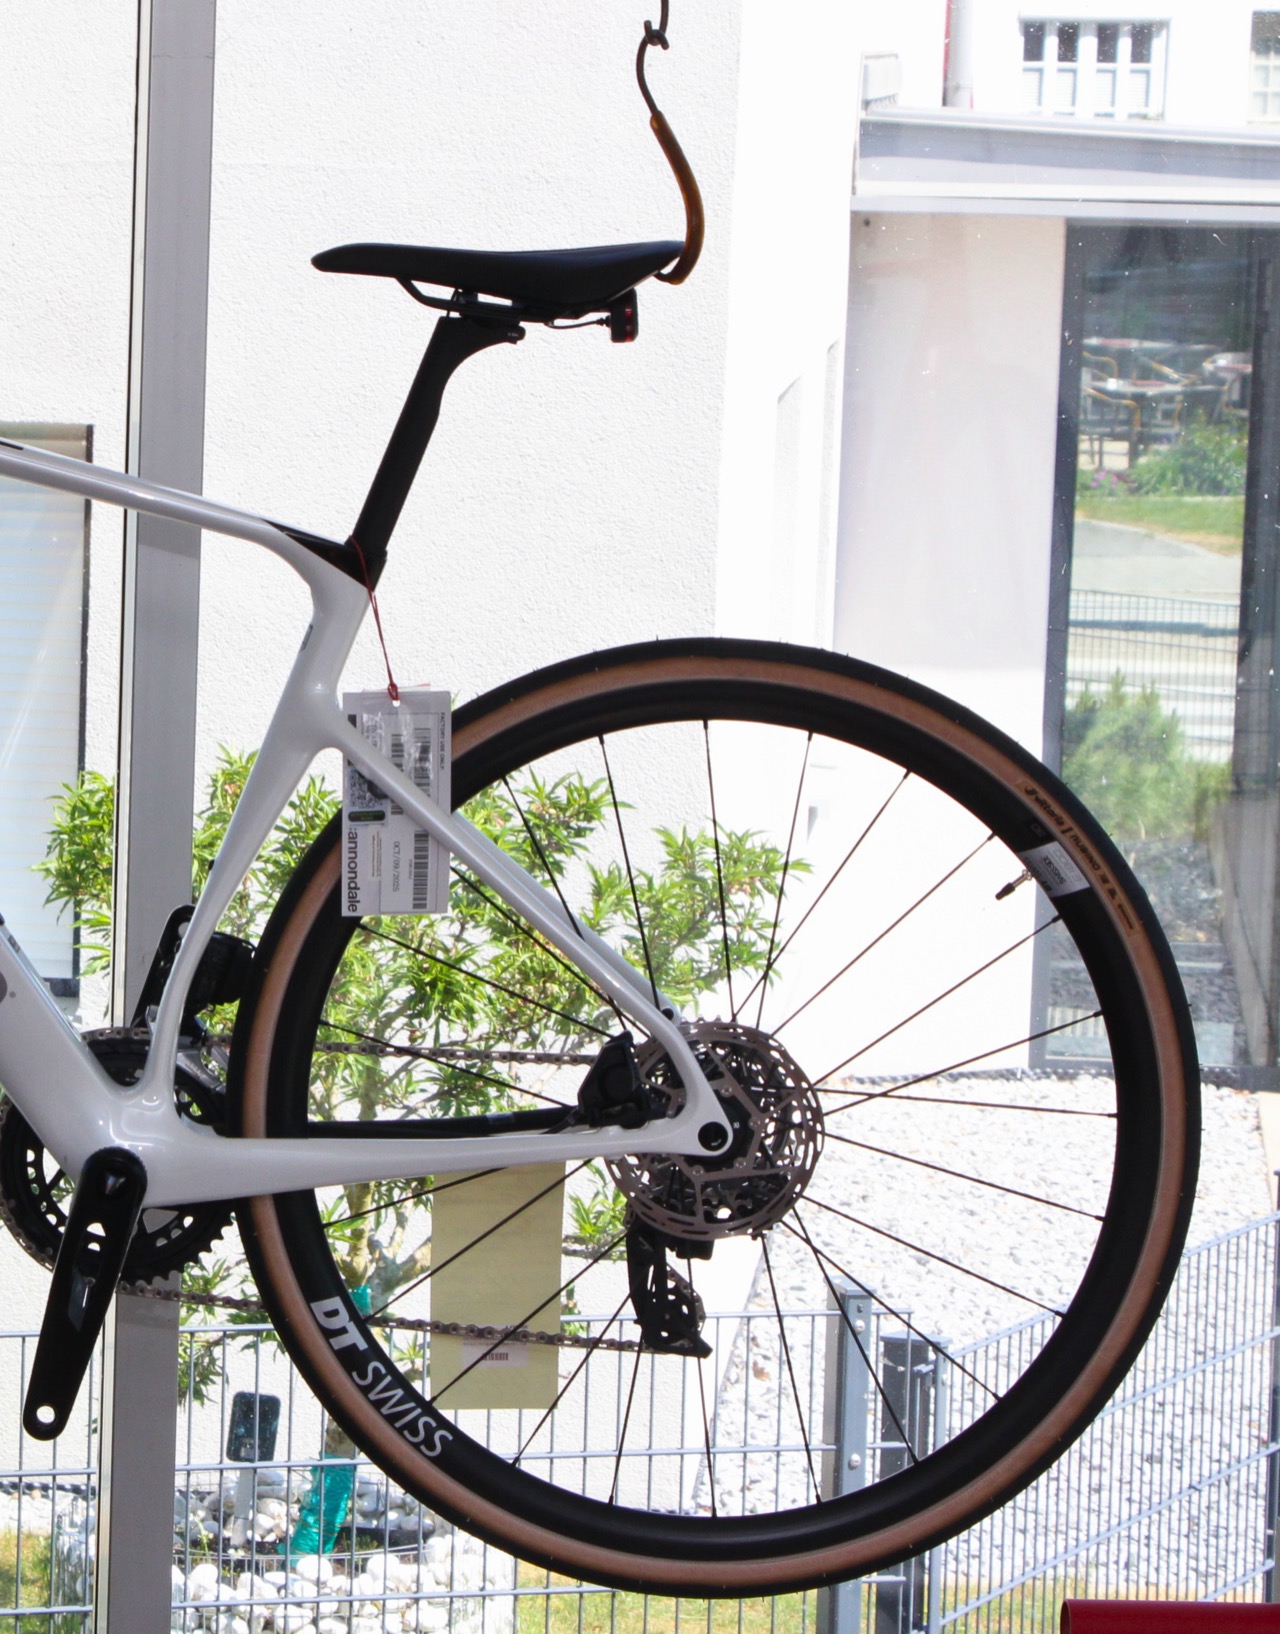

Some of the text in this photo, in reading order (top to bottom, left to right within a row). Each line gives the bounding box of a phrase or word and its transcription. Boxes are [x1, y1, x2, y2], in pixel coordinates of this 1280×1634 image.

[391, 840, 401, 893] OCT/09/2025
[310, 1296, 453, 1457] DT SWISS
